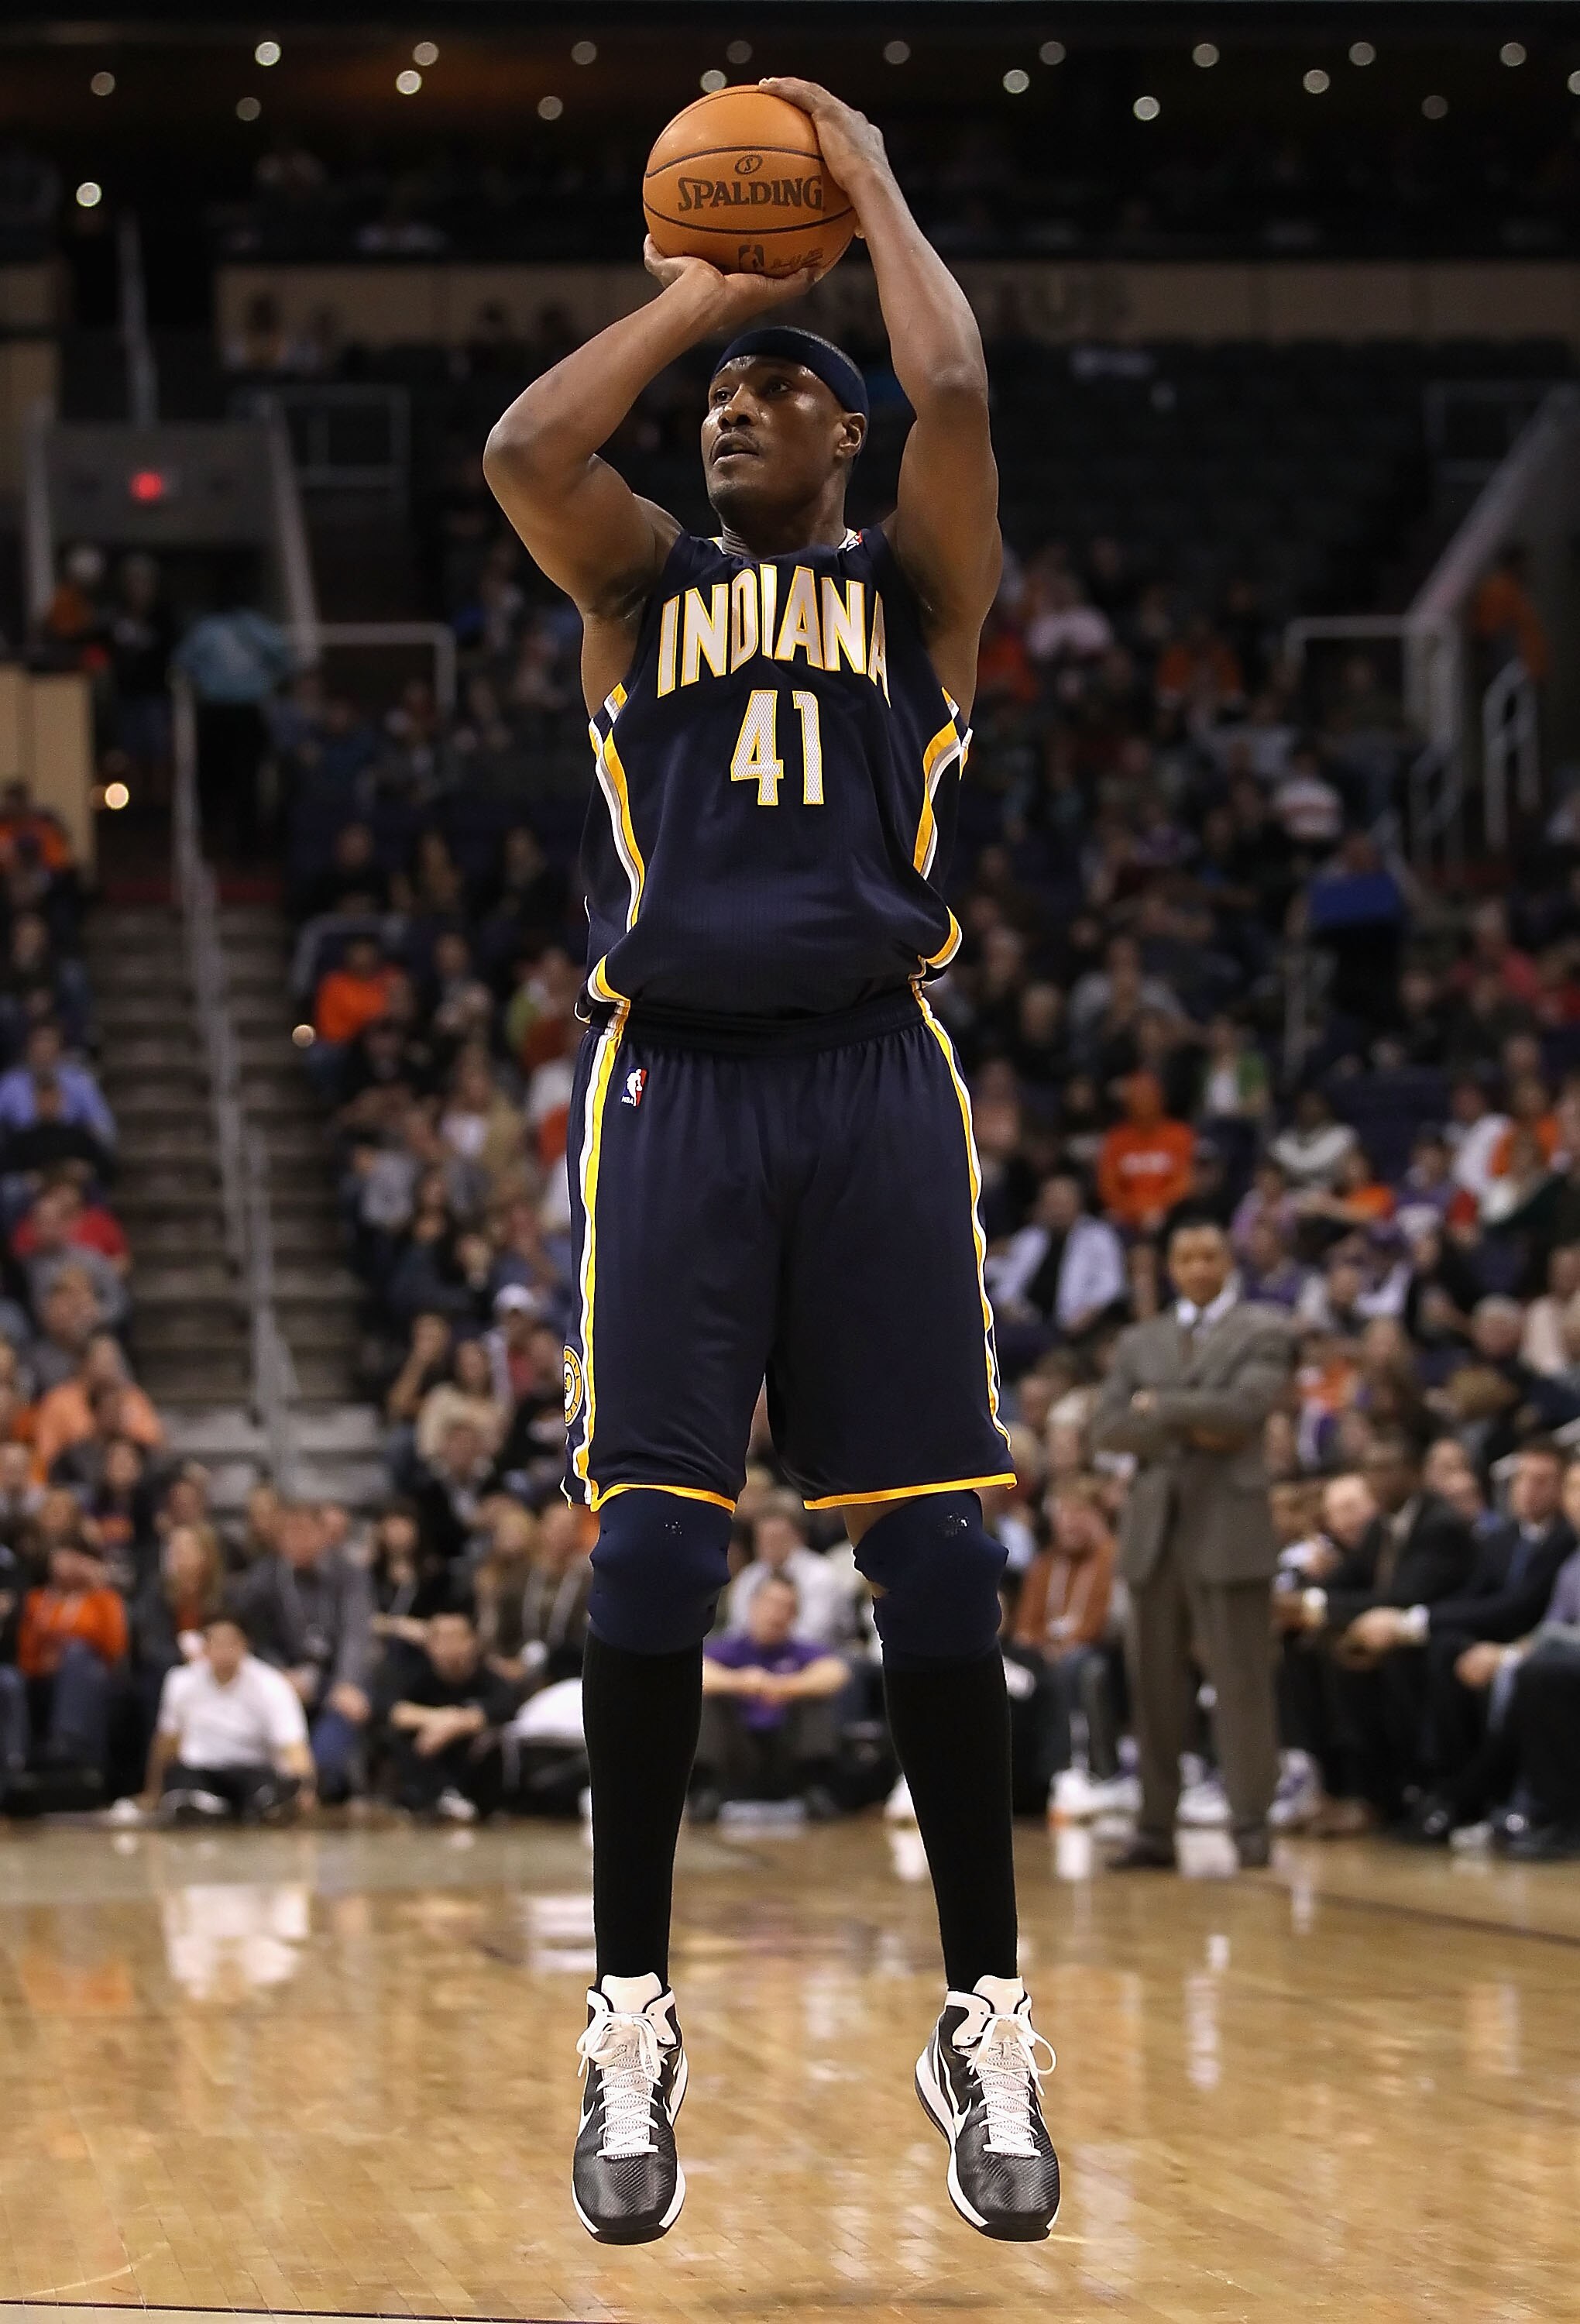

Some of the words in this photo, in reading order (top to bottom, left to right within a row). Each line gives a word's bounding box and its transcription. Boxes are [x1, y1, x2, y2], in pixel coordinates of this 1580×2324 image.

[678, 177, 823, 211] SPALDING
[657, 563, 891, 708] INDIANA
[730, 689, 824, 806] 41
